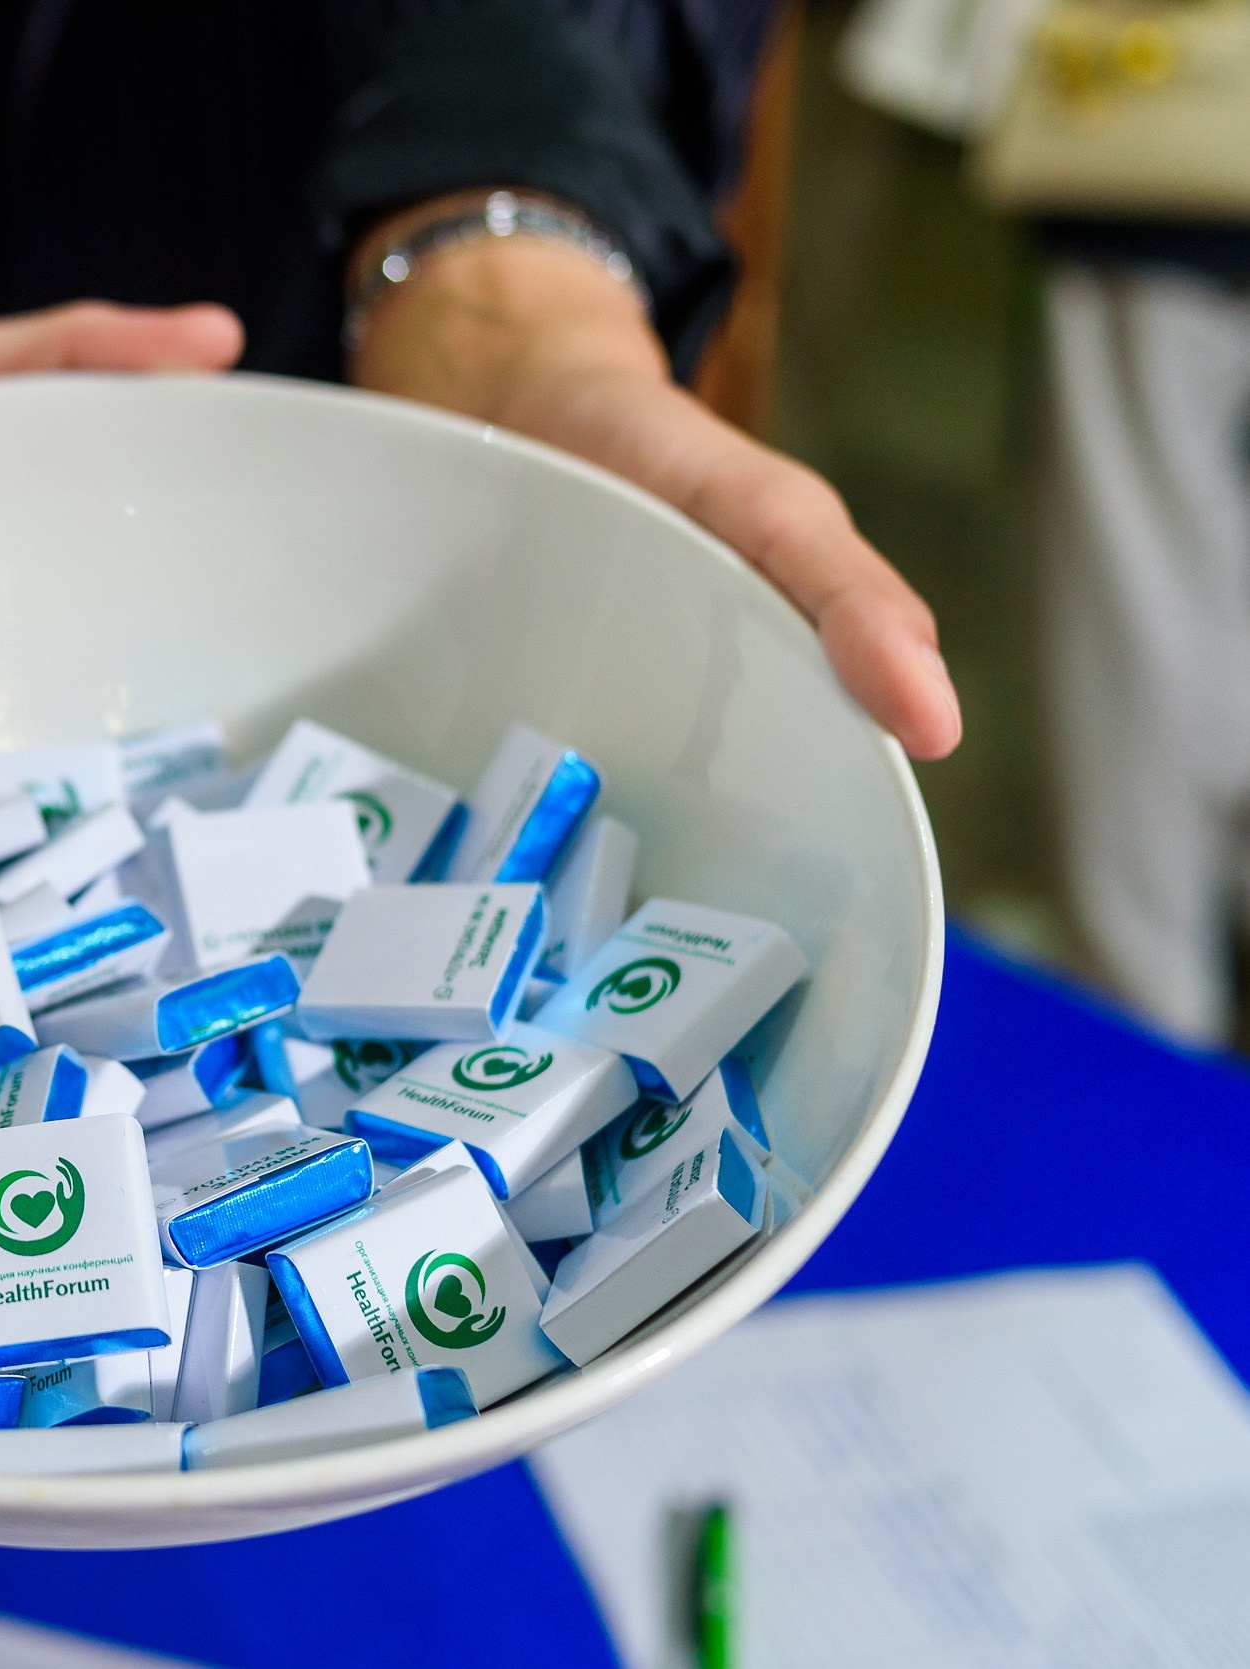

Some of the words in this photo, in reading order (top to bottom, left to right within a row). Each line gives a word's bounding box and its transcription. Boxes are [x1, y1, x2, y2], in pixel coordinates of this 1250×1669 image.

[397, 1086, 495, 1122] HealthForum
[210, 1148, 309, 1190] Захидам
[17, 1265, 62, 1278] научных
[63, 1254, 134, 1271] конференций
[355, 1240, 389, 1303] Организация
[386, 1303, 408, 1347] научных
[30, 1366, 72, 1395] Forum
